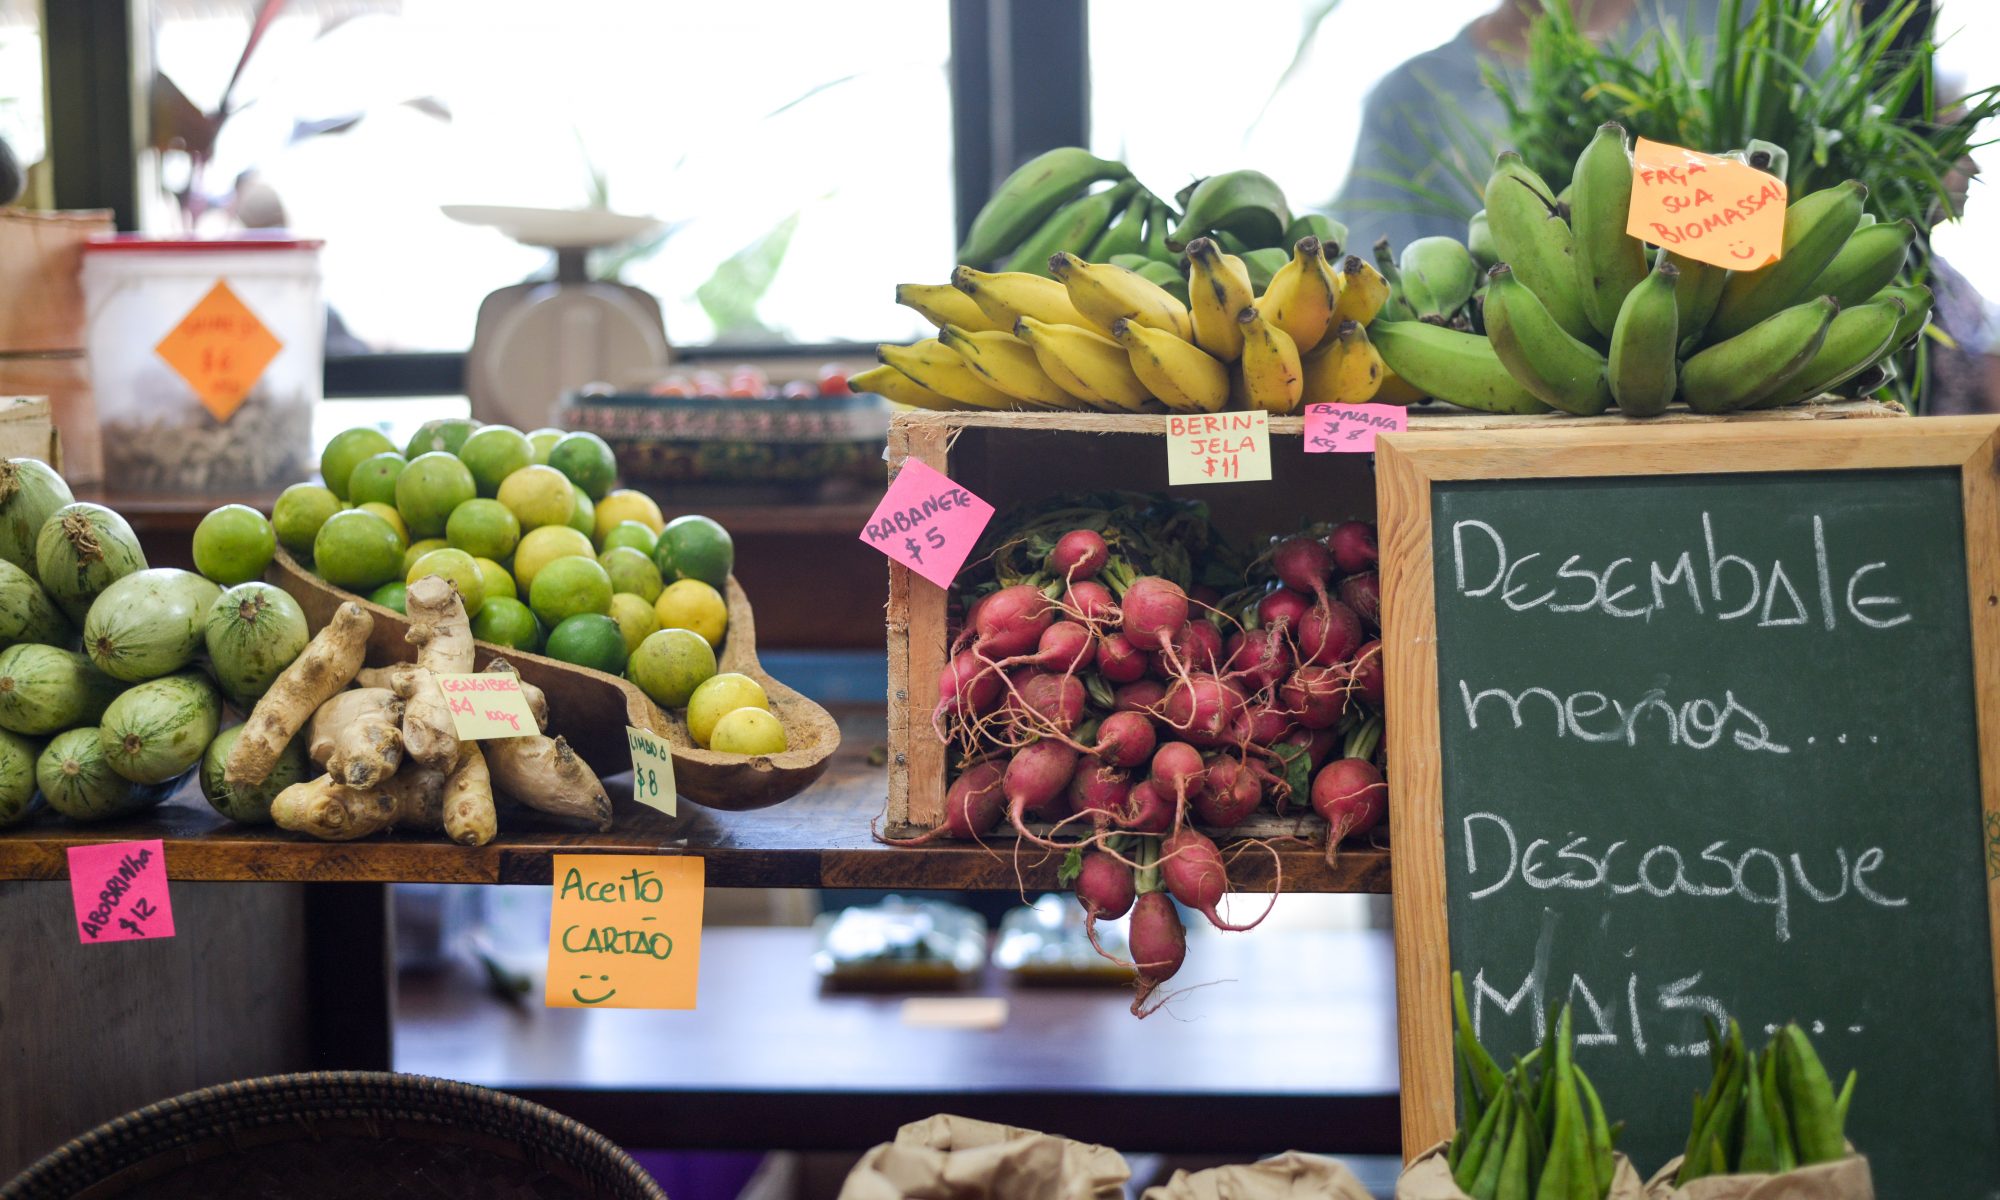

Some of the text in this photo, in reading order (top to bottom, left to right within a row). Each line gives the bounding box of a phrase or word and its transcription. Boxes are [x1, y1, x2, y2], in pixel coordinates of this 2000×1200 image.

[1640, 163, 1707, 187] FAÇA
[1650, 180, 1786, 244] BIOMASSA!
[1662, 188, 1714, 213] SUA
[1170, 415, 1265, 436] BERIN-
[1312, 404, 1398, 430] BANANA
[1190, 436, 1256, 456] JELA
[1201, 454, 1239, 479] $11
[866, 488, 971, 542] RABANETE
[449, 696, 476, 717] $4
[560, 867, 664, 903] Aceito
